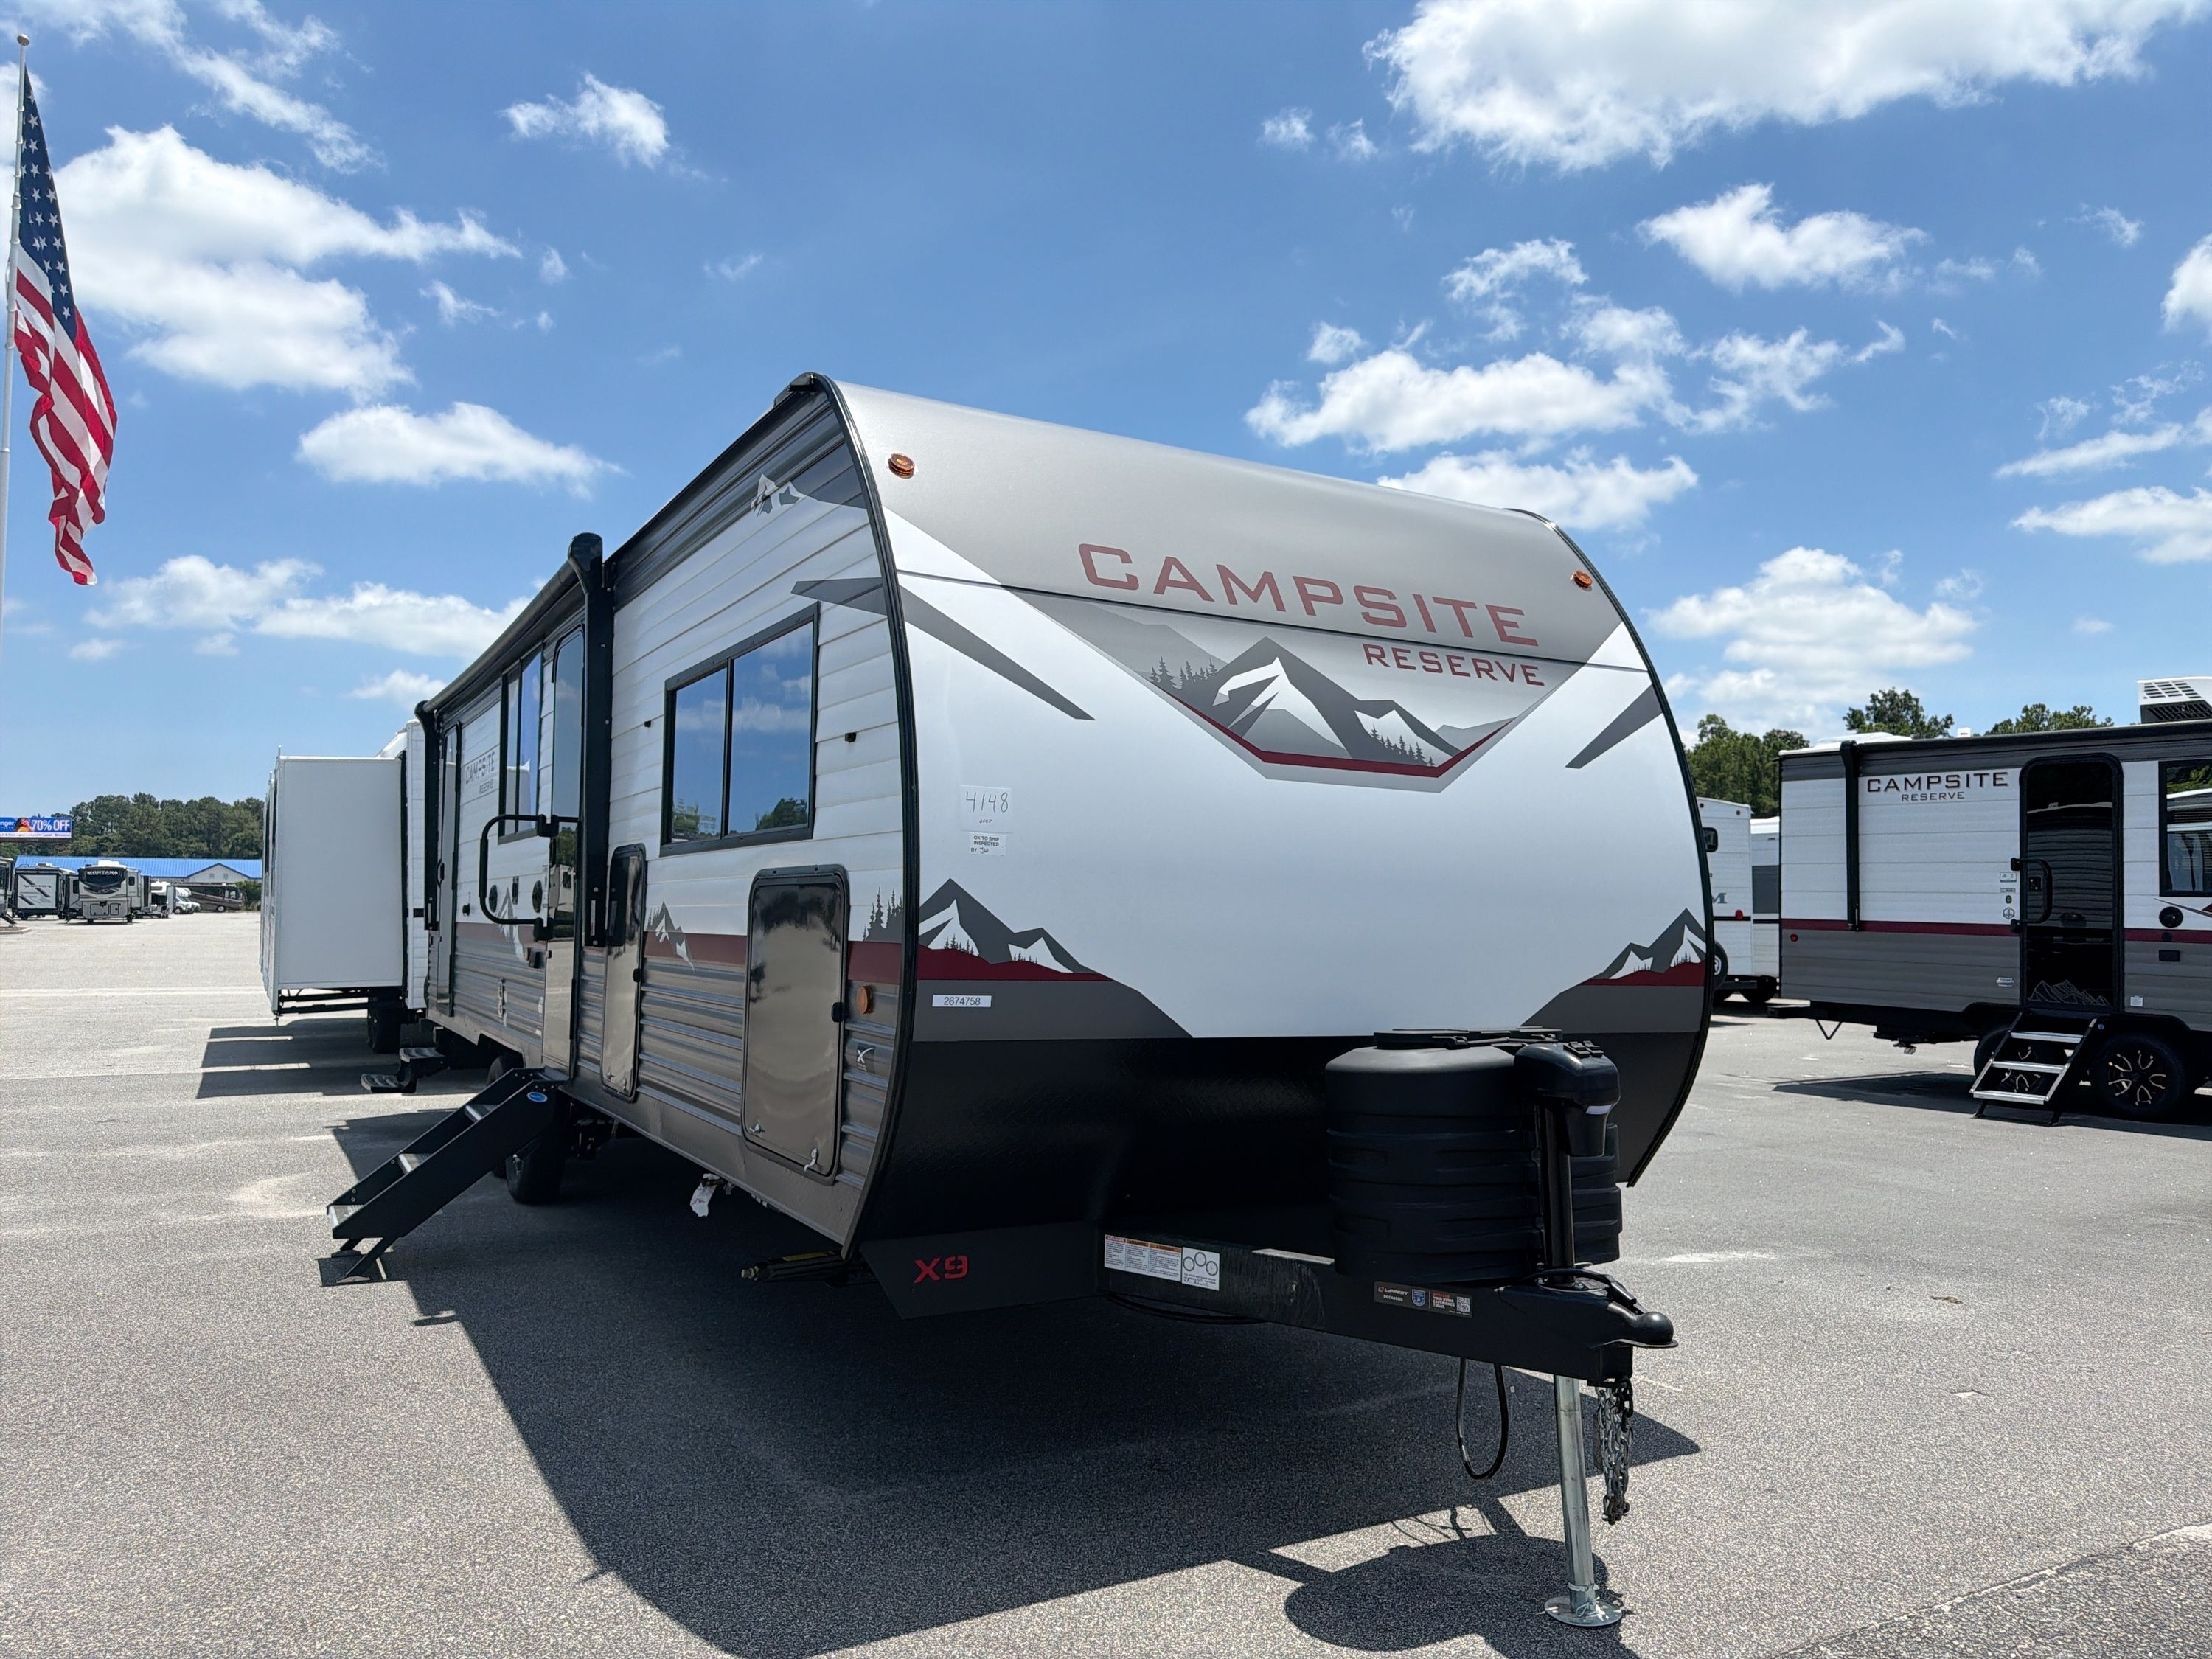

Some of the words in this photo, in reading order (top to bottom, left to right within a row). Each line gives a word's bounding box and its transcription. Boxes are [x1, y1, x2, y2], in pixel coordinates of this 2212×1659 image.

[1078, 543, 1539, 647] CAMPSITE
[1362, 644, 1545, 686] RESERVE
[466, 751, 495, 784] CAMPSITE
[1867, 772, 2009, 793] CAMPSITE
[966, 791, 1009, 813] 4148
[1902, 791, 1965, 801] RESERVE
[32, 819, 52, 831] 70%
[53, 820, 70, 831] OFF
[943, 996, 981, 1006] 2674758
[914, 1255, 969, 1284] X9
